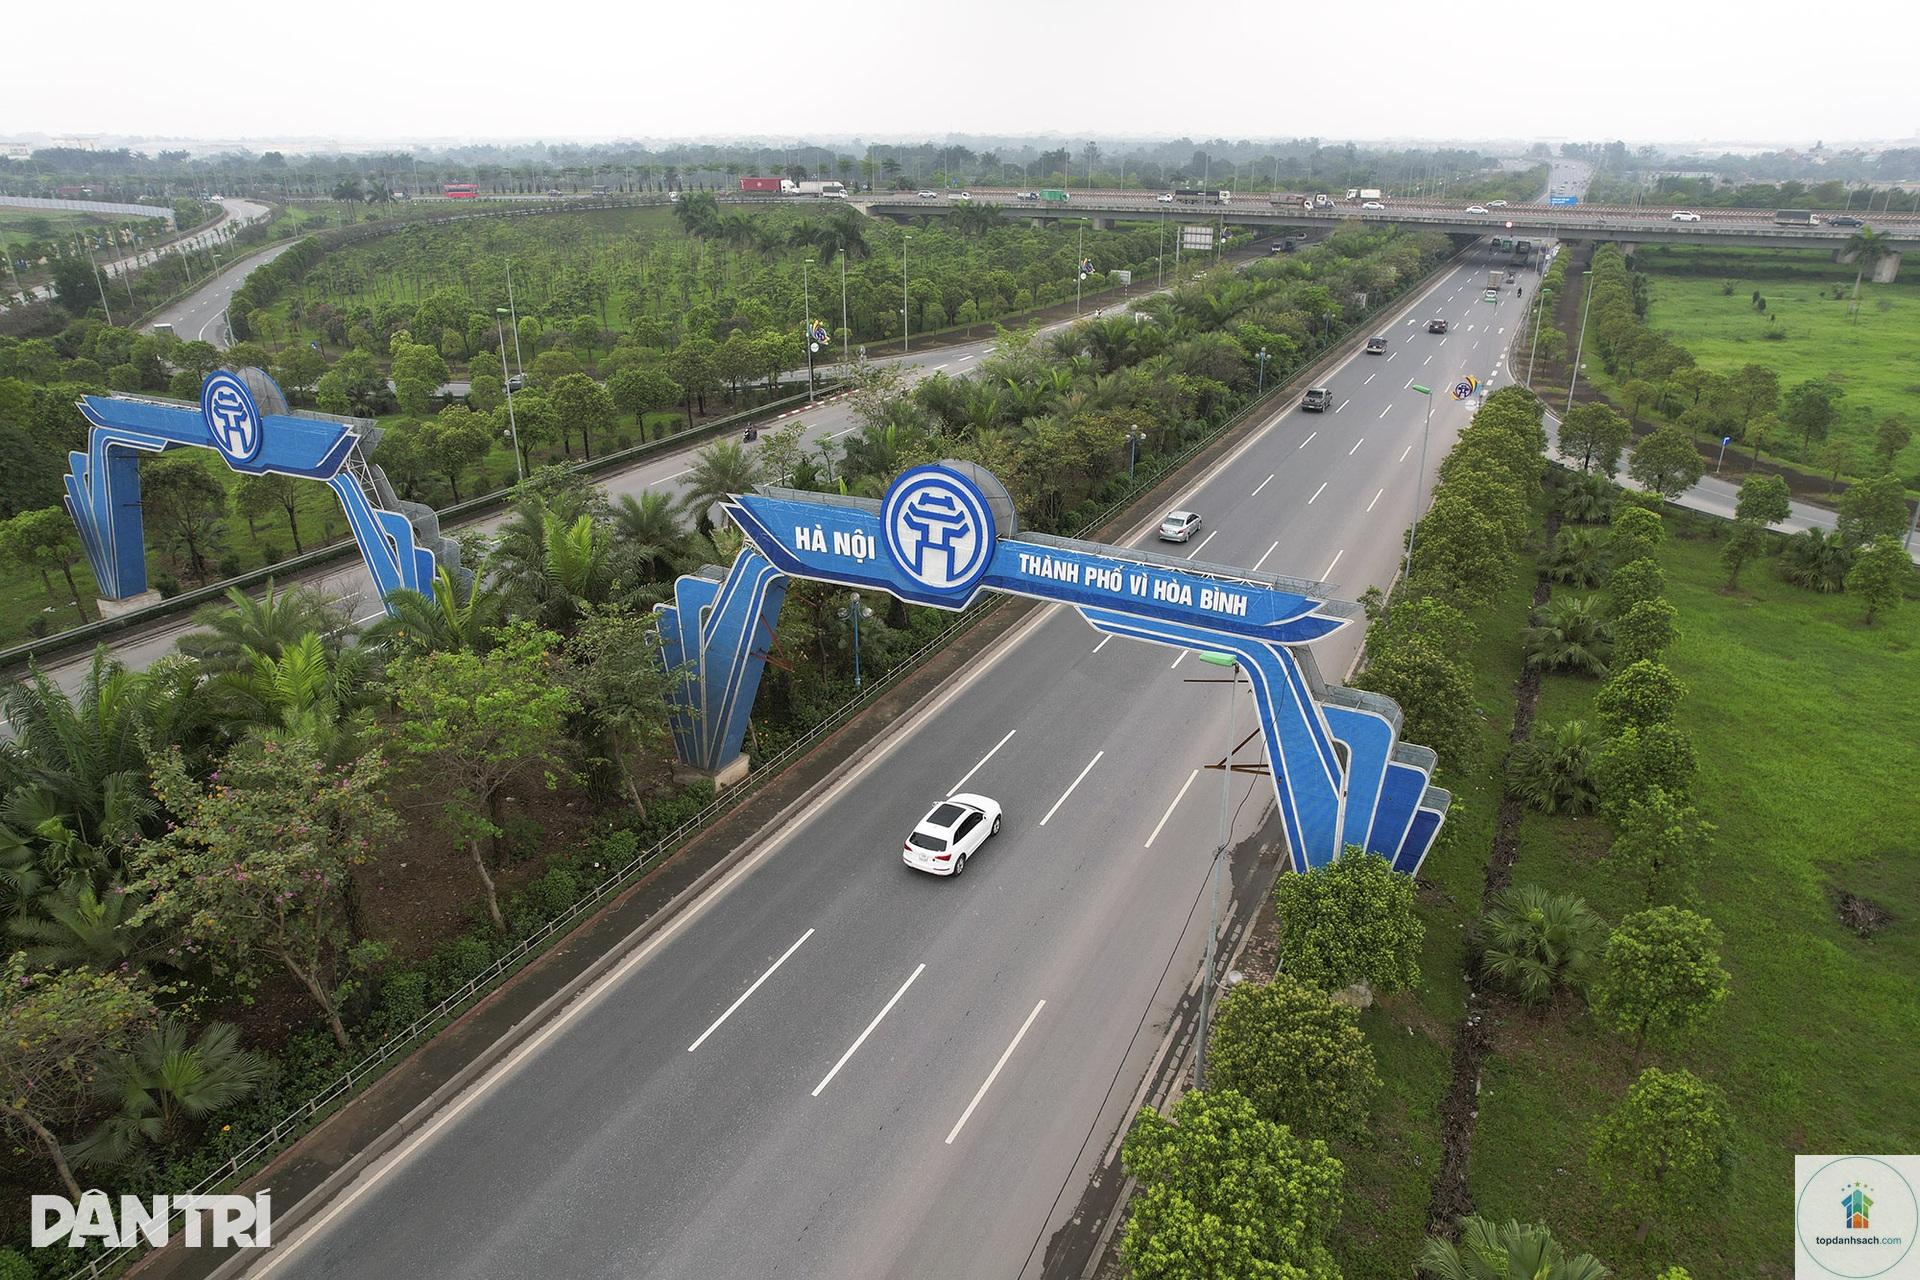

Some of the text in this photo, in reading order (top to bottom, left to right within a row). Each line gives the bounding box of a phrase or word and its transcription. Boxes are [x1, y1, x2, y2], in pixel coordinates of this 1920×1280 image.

[795, 523, 876, 564] HÀ NỘI
[1019, 553, 1248, 617] THÀNH PHỐ VÌ HÒA BÌNH
